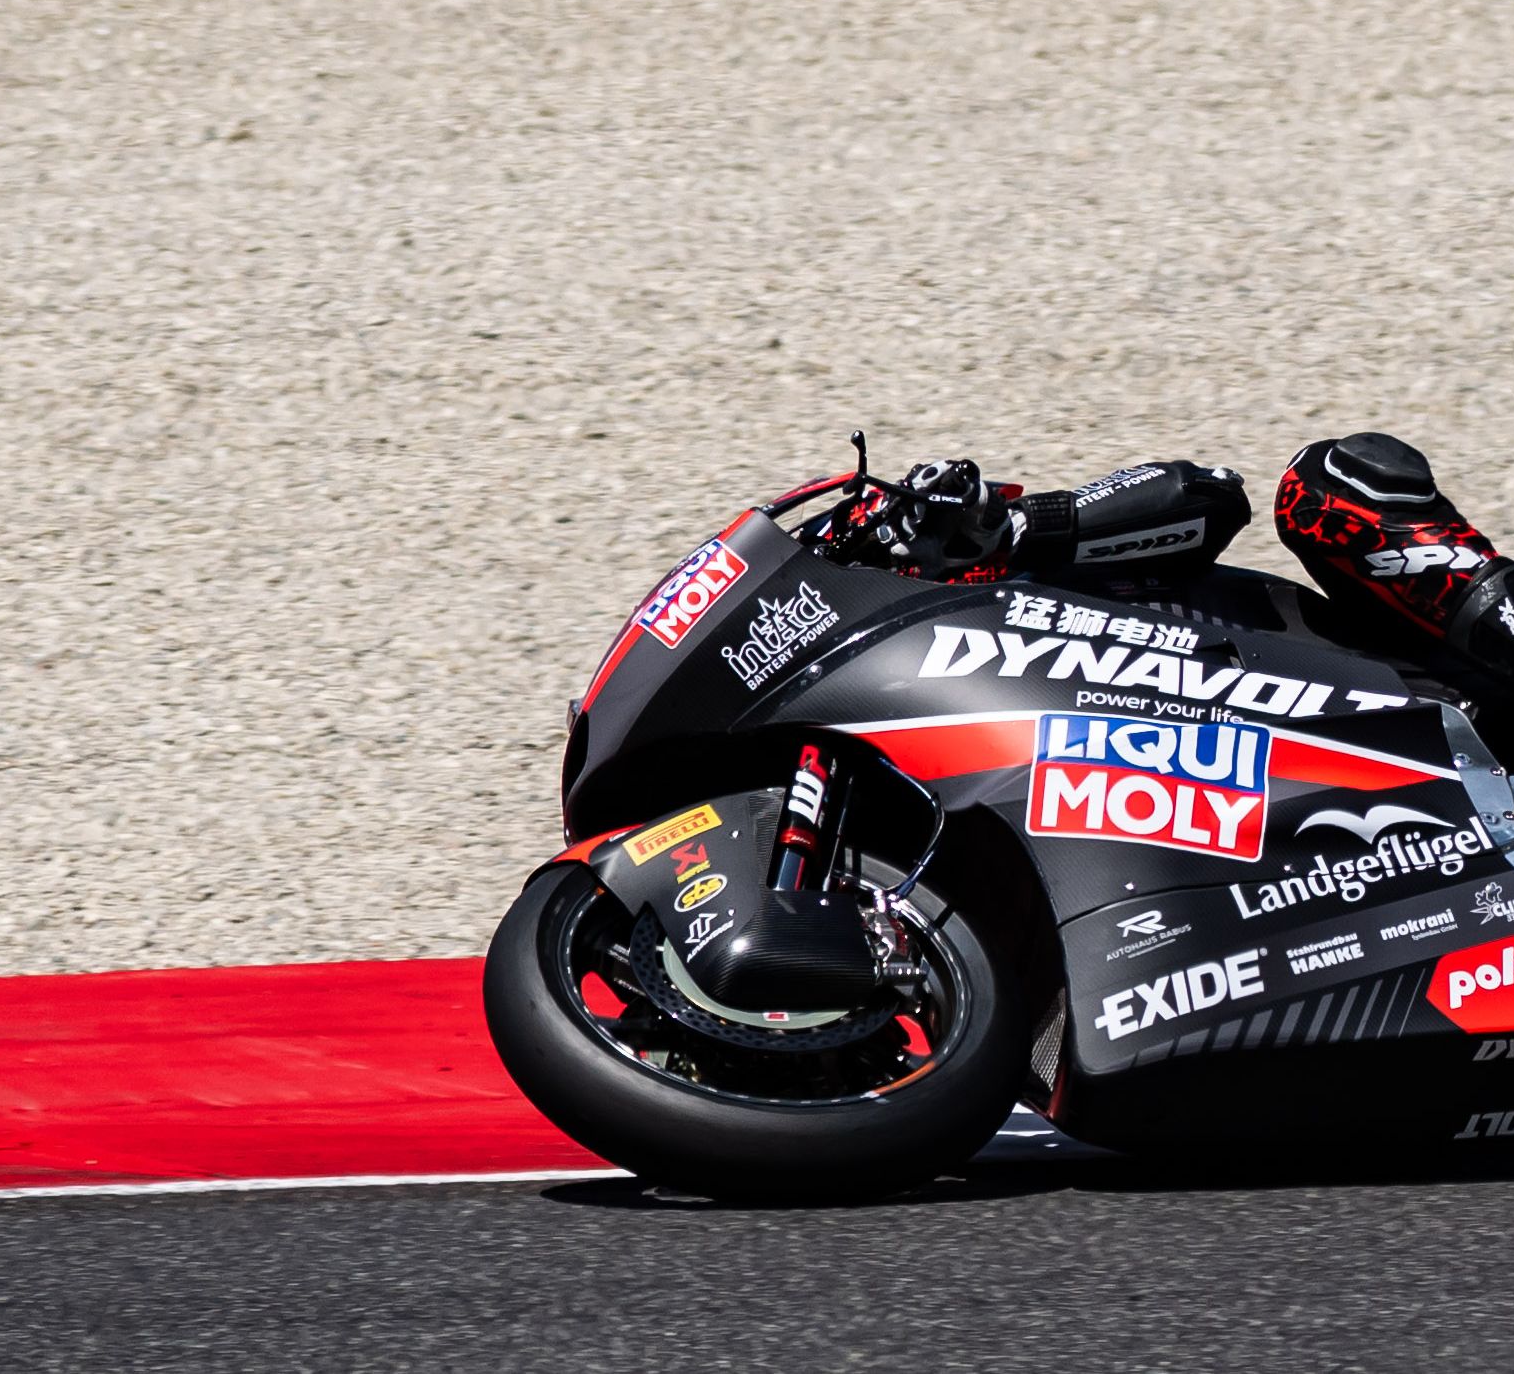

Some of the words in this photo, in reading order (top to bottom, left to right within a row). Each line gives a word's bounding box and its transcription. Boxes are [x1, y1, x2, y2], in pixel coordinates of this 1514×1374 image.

[1123, 469, 1166, 488] POWER
[1083, 529, 1198, 558] SPIDI
[653, 548, 737, 642] MOLY
[1004, 591, 1199, 655] 猛狮电池
[746, 649, 793, 691] BATTERY
[799, 611, 840, 647] POWER
[917, 624, 1410, 718] DYNAVOLT
[1076, 689, 1150, 709] power
[1152, 699, 1206, 719] your
[1210, 708, 1245, 724] life
[1047, 718, 1260, 788] LIQUI
[788, 745, 826, 825] WP
[1040, 767, 1262, 849] MOLY
[634, 811, 710, 855] PIRELLI
[681, 876, 722, 909] sbs
[1230, 815, 1493, 920] Landgeflügel
[1106, 934, 1157, 962] AUTOHAUS
[1159, 923, 1192, 940] RABUS
[1286, 932, 1358, 959] Stahlrundbau
[1380, 908, 1455, 940] mokrani
[1290, 942, 1364, 975] HANKE
[1094, 949, 1265, 1041] EXIDE
